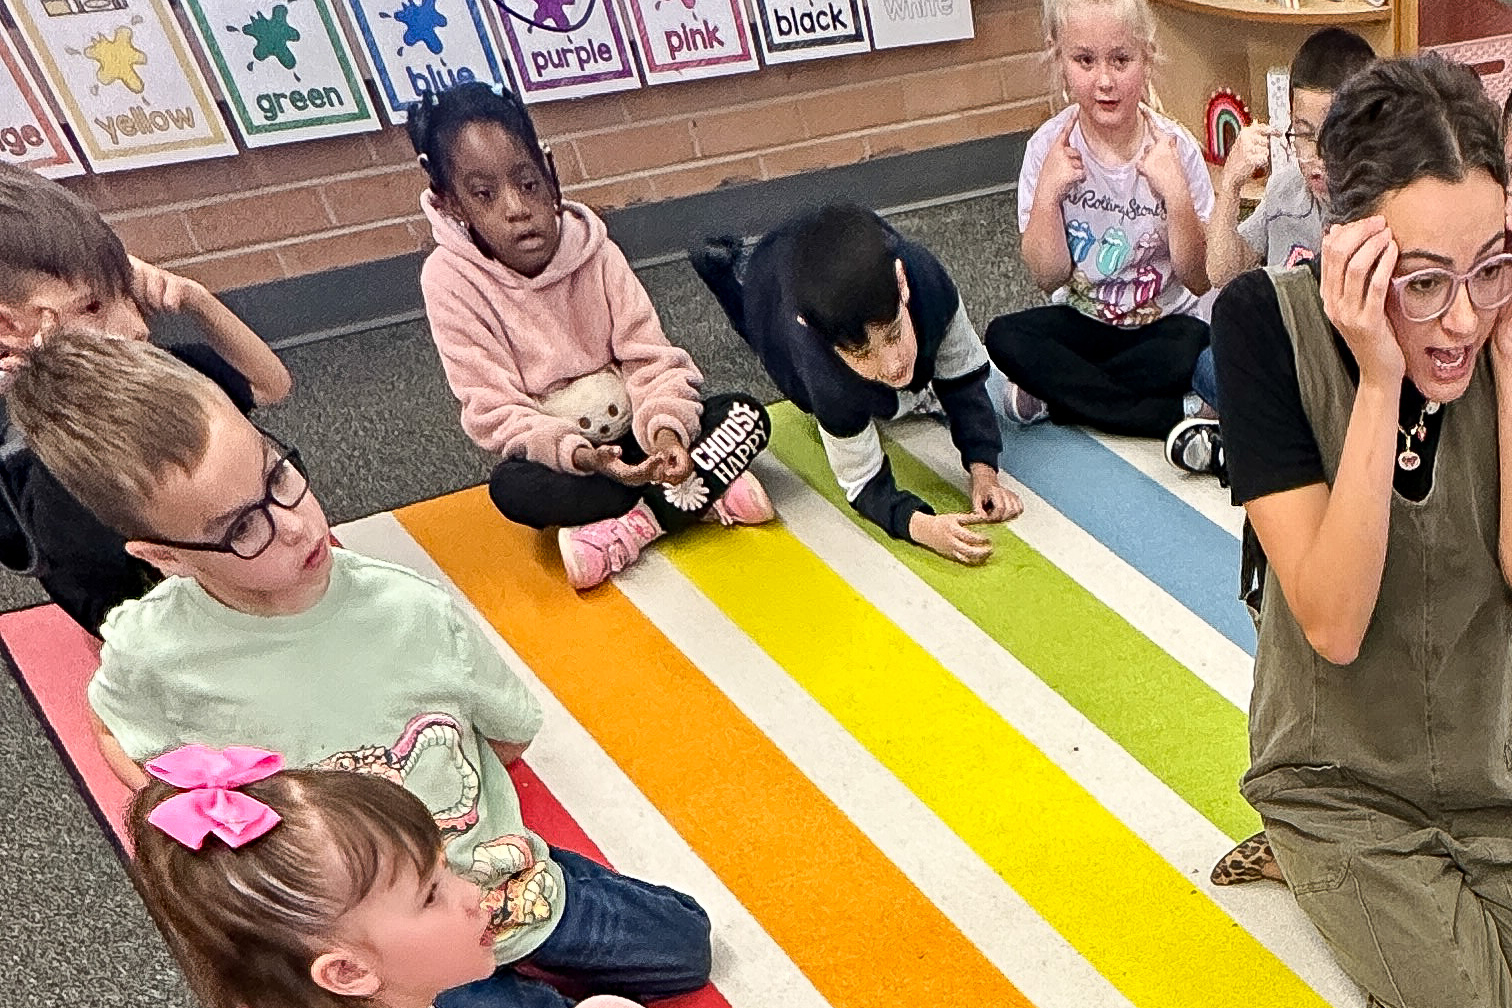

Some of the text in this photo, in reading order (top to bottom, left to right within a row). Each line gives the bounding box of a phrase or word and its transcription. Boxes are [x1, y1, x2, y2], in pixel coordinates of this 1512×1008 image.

[774, 2, 848, 36] black
[531, 38, 613, 77] purple
[664, 19, 725, 60] pink
[256, 86, 344, 121] green
[95, 106, 195, 145] yellow
[1082, 189, 1127, 226] Rolling
[690, 401, 760, 471] CHOOSE
[713, 420, 767, 485] HAPPY
